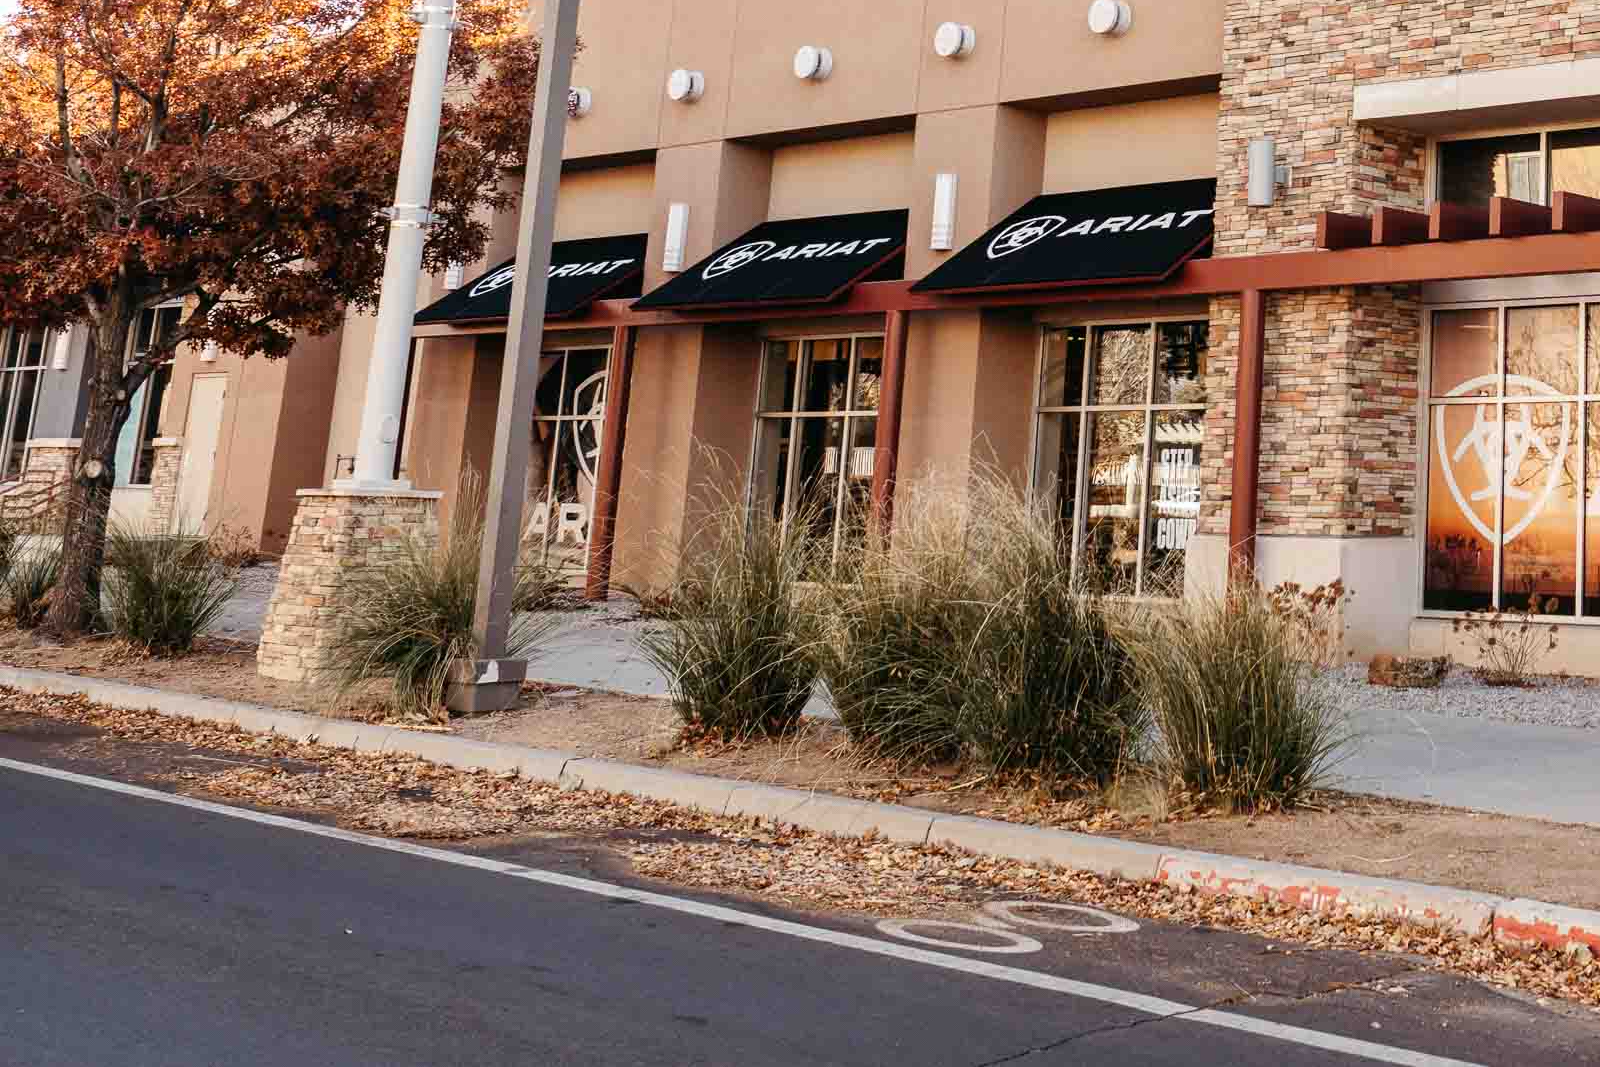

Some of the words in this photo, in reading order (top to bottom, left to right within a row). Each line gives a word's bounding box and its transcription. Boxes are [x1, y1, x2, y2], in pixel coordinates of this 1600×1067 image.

[1055, 209, 1216, 238] ARIAT
[760, 237, 892, 262] ARIAT
[547, 258, 636, 279] RIAT
